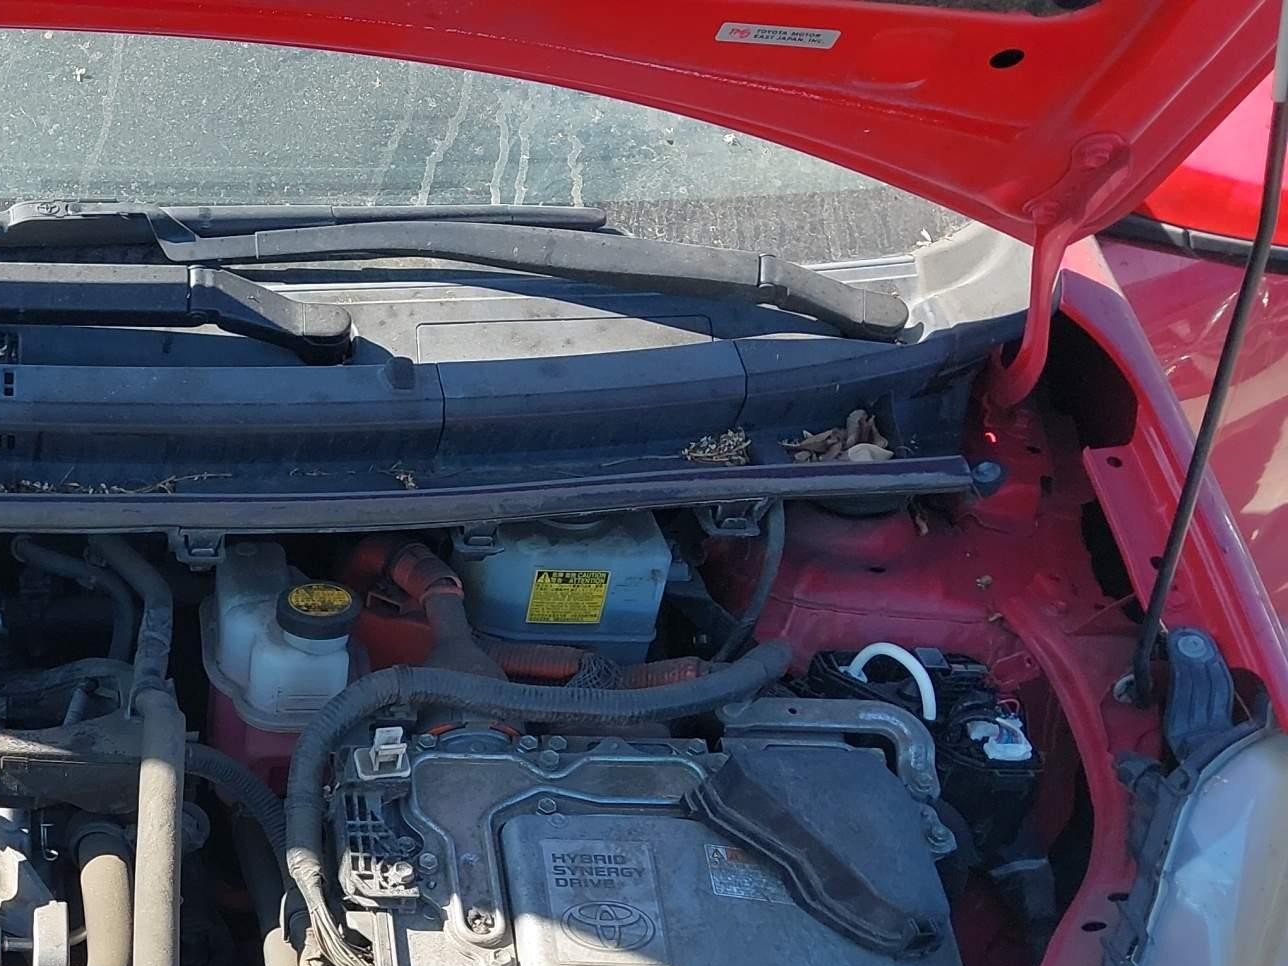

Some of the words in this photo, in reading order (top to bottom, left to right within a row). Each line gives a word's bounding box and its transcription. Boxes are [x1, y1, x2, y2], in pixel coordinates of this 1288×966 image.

[756, 28, 789, 36] TOYOTA
[552, 853, 626, 865] HYBRID
[552, 865, 646, 878] SYNERGY
[554, 877, 616, 889] DRIVE
